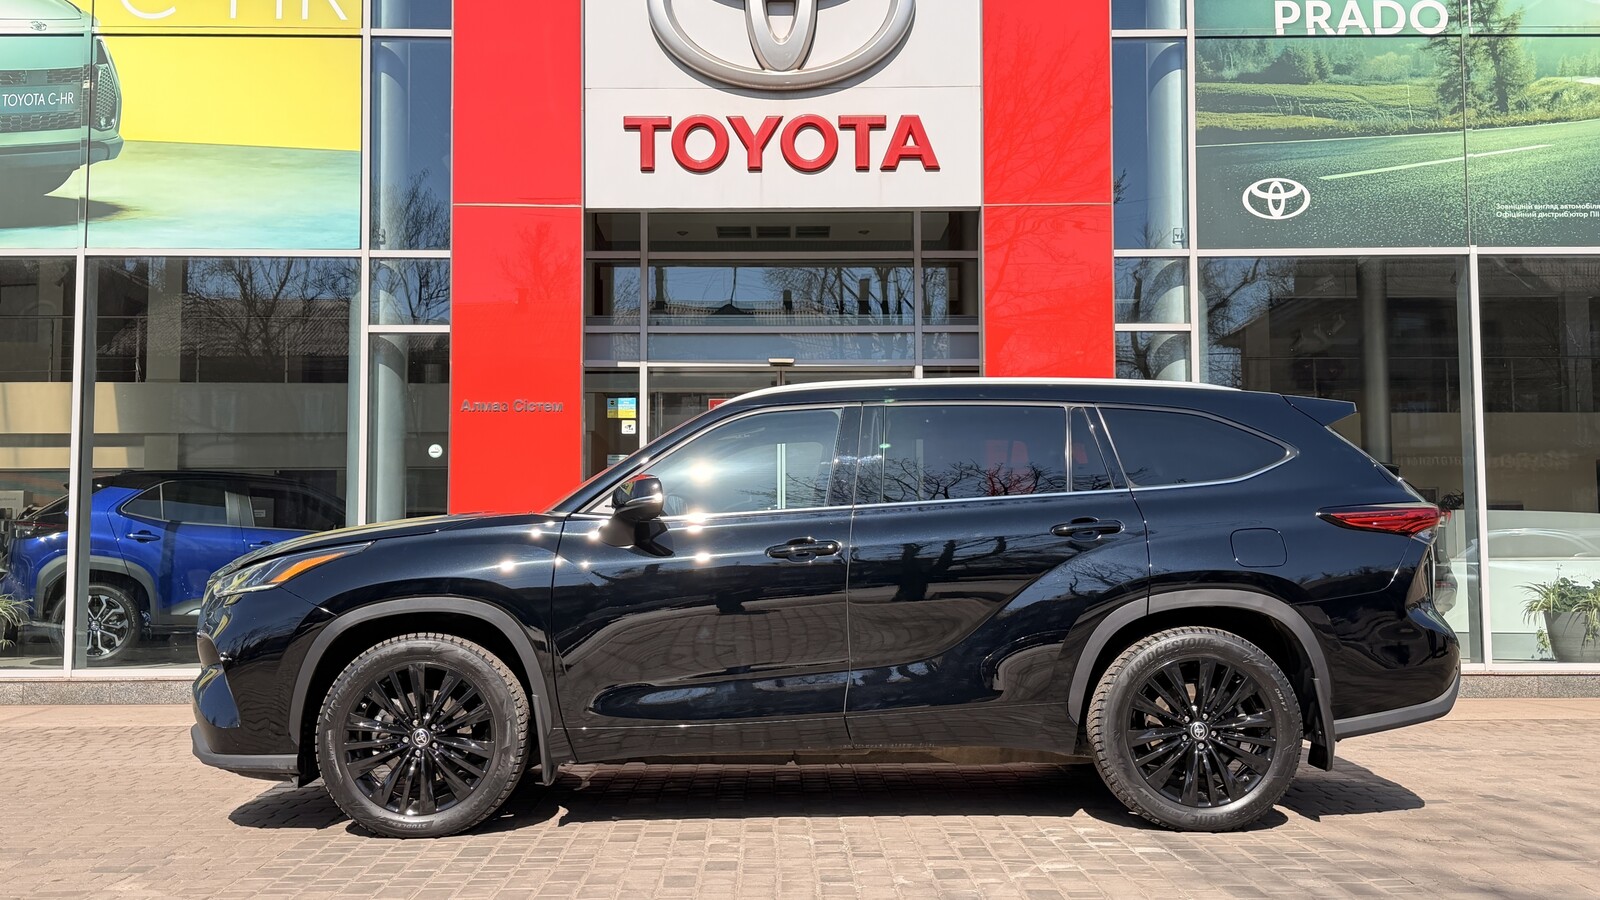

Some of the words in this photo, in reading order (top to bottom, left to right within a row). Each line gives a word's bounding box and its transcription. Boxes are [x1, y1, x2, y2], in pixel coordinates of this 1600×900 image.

[1274, 0, 1449, 35] PRADO
[2, 93, 46, 107] TOYOTA
[48, 91, 74, 105] C-HR
[623, 114, 941, 174] TOYOTA
[460, 399, 508, 413] Алмаз
[513, 399, 563, 413] Сістем
[1125, 637, 1214, 678] BRIDGESTONE
